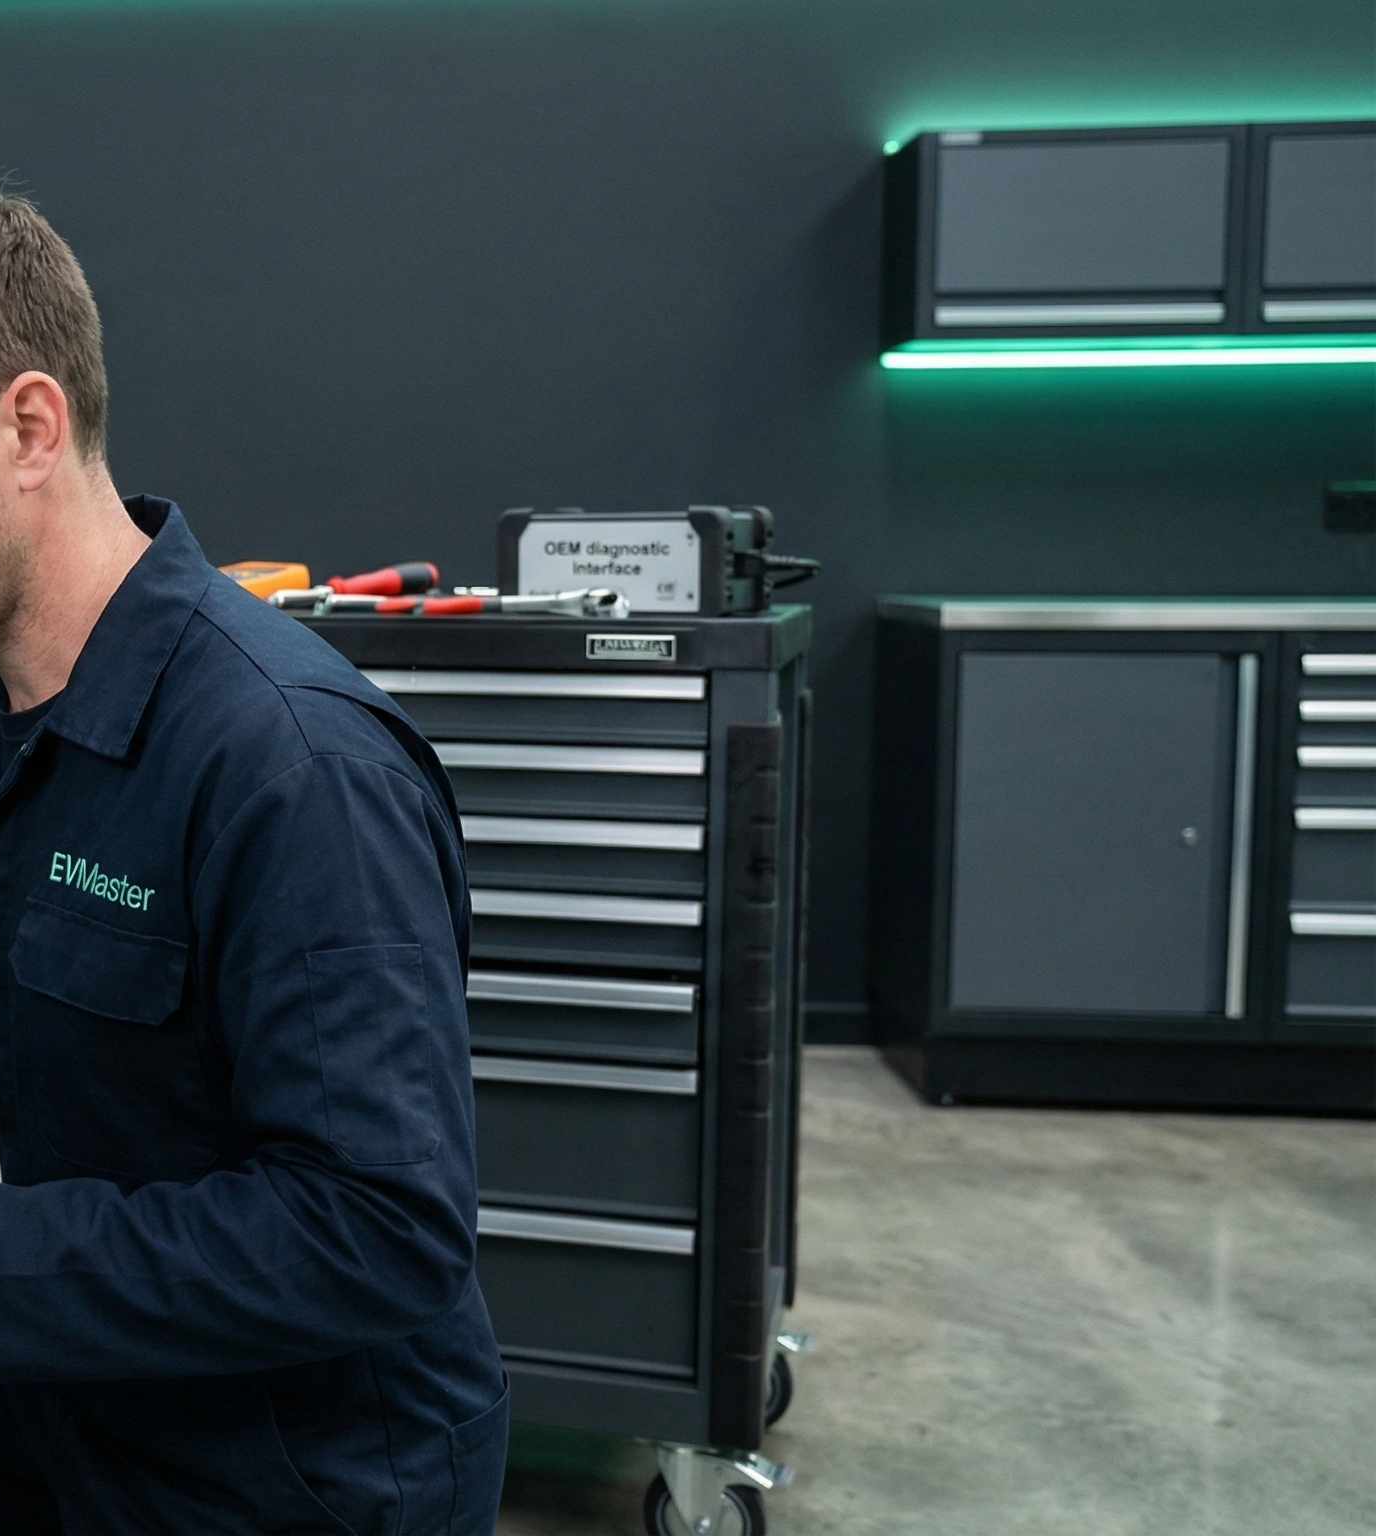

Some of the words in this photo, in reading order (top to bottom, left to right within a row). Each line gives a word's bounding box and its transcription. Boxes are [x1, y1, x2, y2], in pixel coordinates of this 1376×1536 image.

[544, 541, 581, 555] OEM
[586, 541, 670, 558] diagnostic
[49, 851, 155, 911] EVMaster
